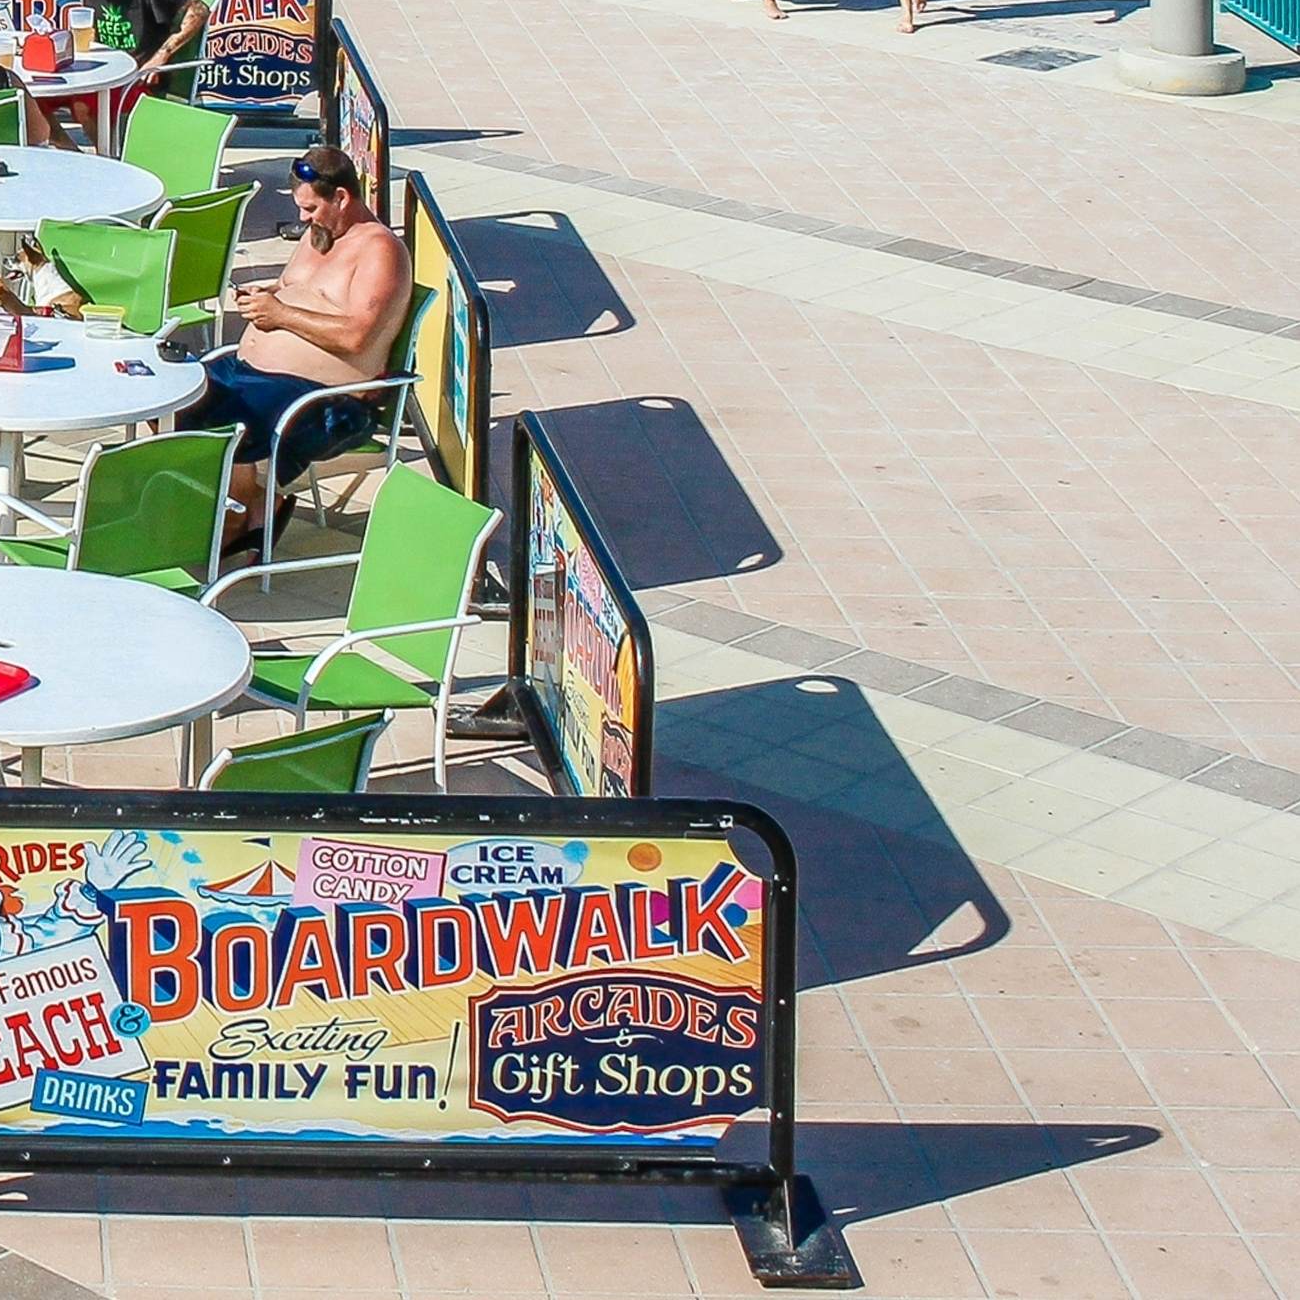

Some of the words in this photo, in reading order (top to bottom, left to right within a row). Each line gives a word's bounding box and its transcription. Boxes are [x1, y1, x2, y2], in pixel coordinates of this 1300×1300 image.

[97, 19, 131, 36] KEEP
[207, 31, 313, 65] RCADES
[237, 64, 311, 91] Shops
[310, 844, 429, 882] COTTON
[477, 845, 536, 866] ICE
[311, 873, 412, 903] CANDY
[448, 861, 565, 886] CREAM
[116, 867, 751, 1023] BOARDWALK
[115, 1003, 145, 1034] &
[489, 983, 758, 1048] ARCADES
[207, 1016, 390, 1063] Exciting
[616, 1028, 633, 1047] &
[152, 1060, 330, 1100] FAMILY
[492, 1052, 581, 1103] Gift
[593, 1052, 753, 1103] Shops
[41, 1074, 137, 1117] DRINKS
